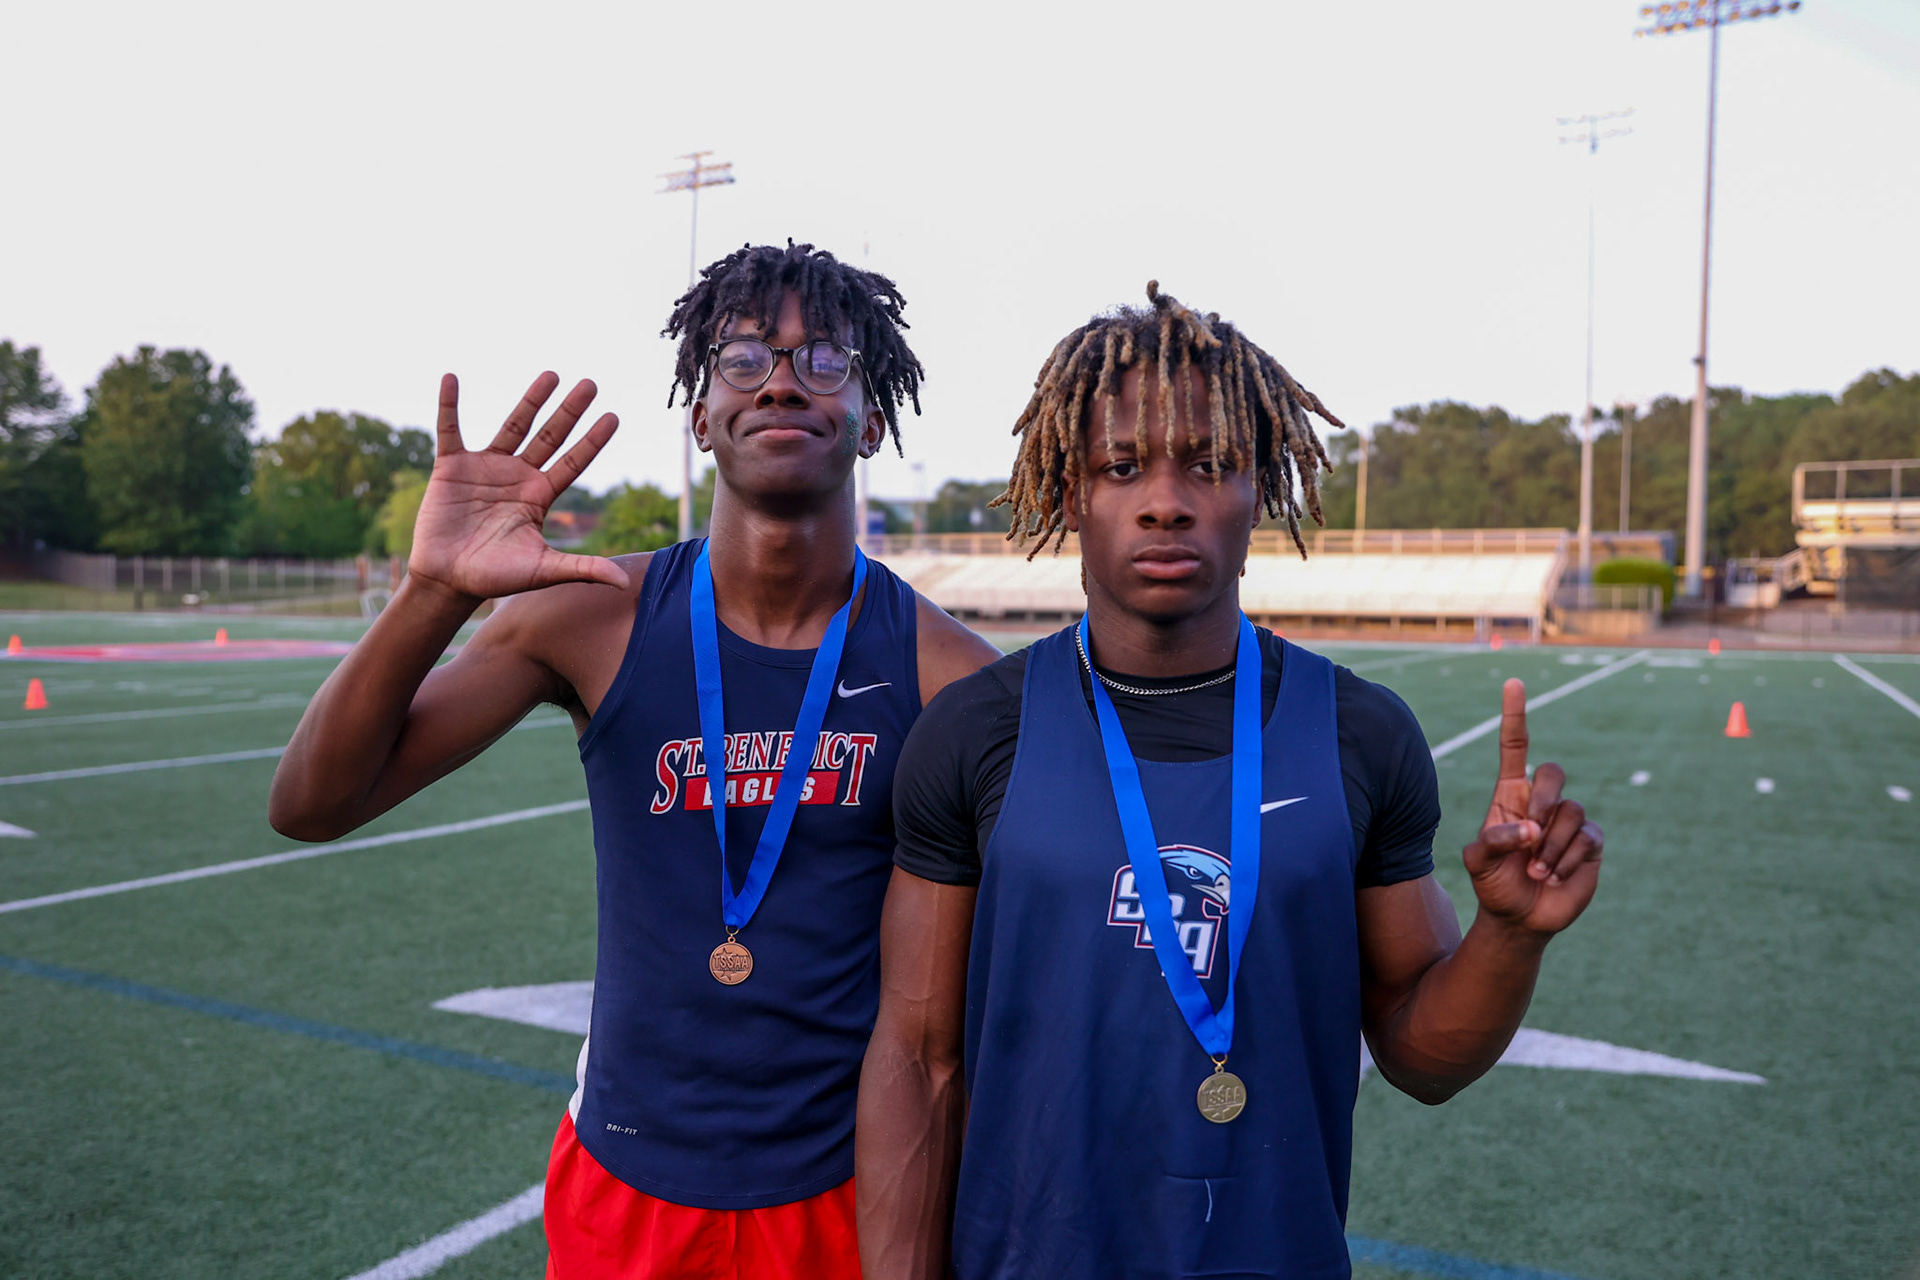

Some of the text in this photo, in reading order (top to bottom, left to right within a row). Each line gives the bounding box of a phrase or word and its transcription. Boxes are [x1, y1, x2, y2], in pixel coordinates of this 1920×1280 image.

[711, 731, 877, 806] ENEICT
[703, 777, 816, 806] AGLS
[713, 954, 749, 968] TSSAA
[606, 1123, 638, 1136] DRI-FIT
